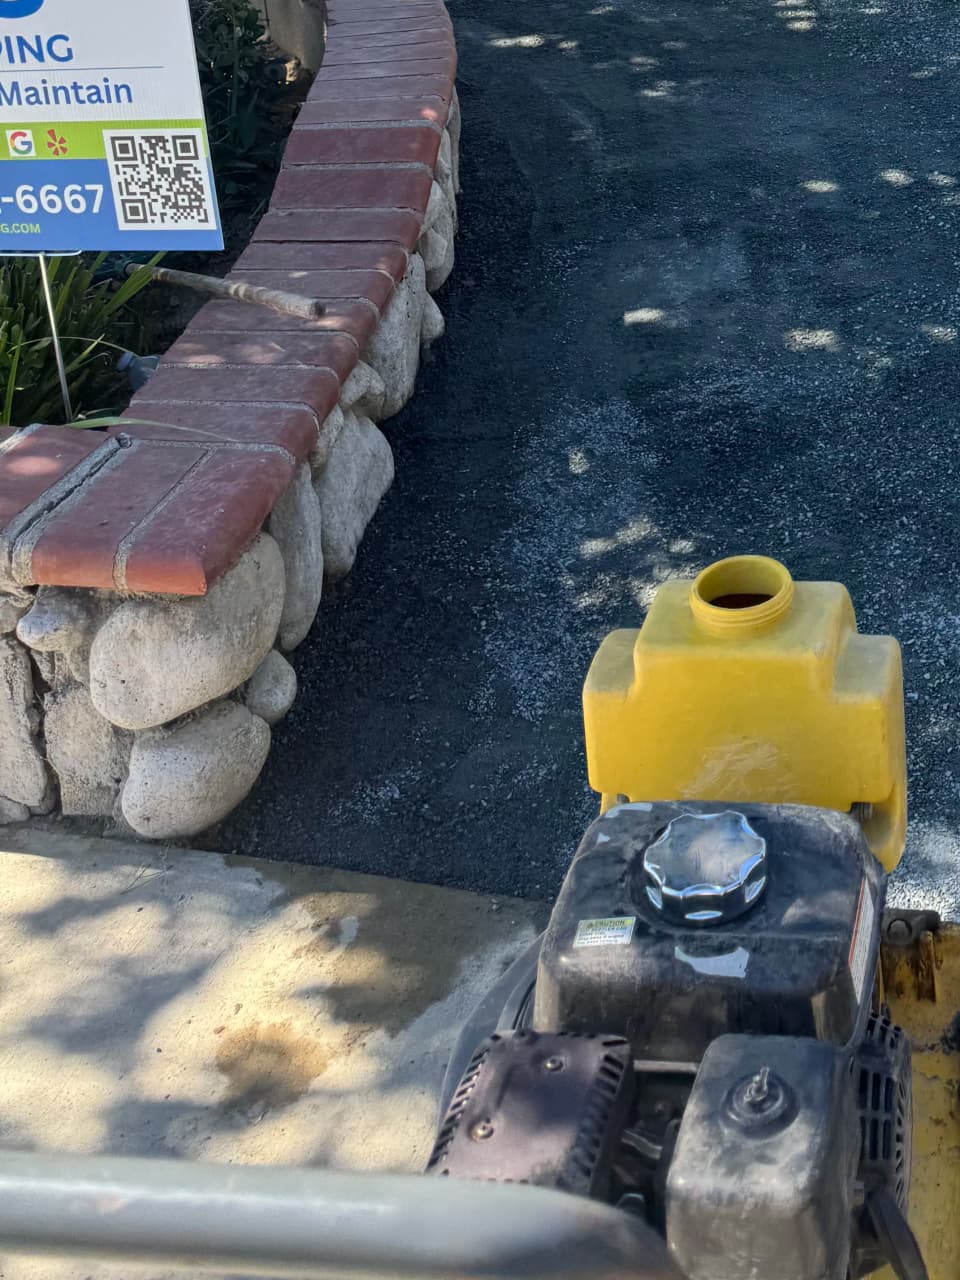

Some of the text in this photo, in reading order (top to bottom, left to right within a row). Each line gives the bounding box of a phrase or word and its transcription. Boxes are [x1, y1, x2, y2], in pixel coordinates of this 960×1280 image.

[0, 33, 74, 64] ING
[0, 77, 133, 106] Maintain
[0, 184, 104, 214] -6667
[0, 223, 41, 234] G.COM
